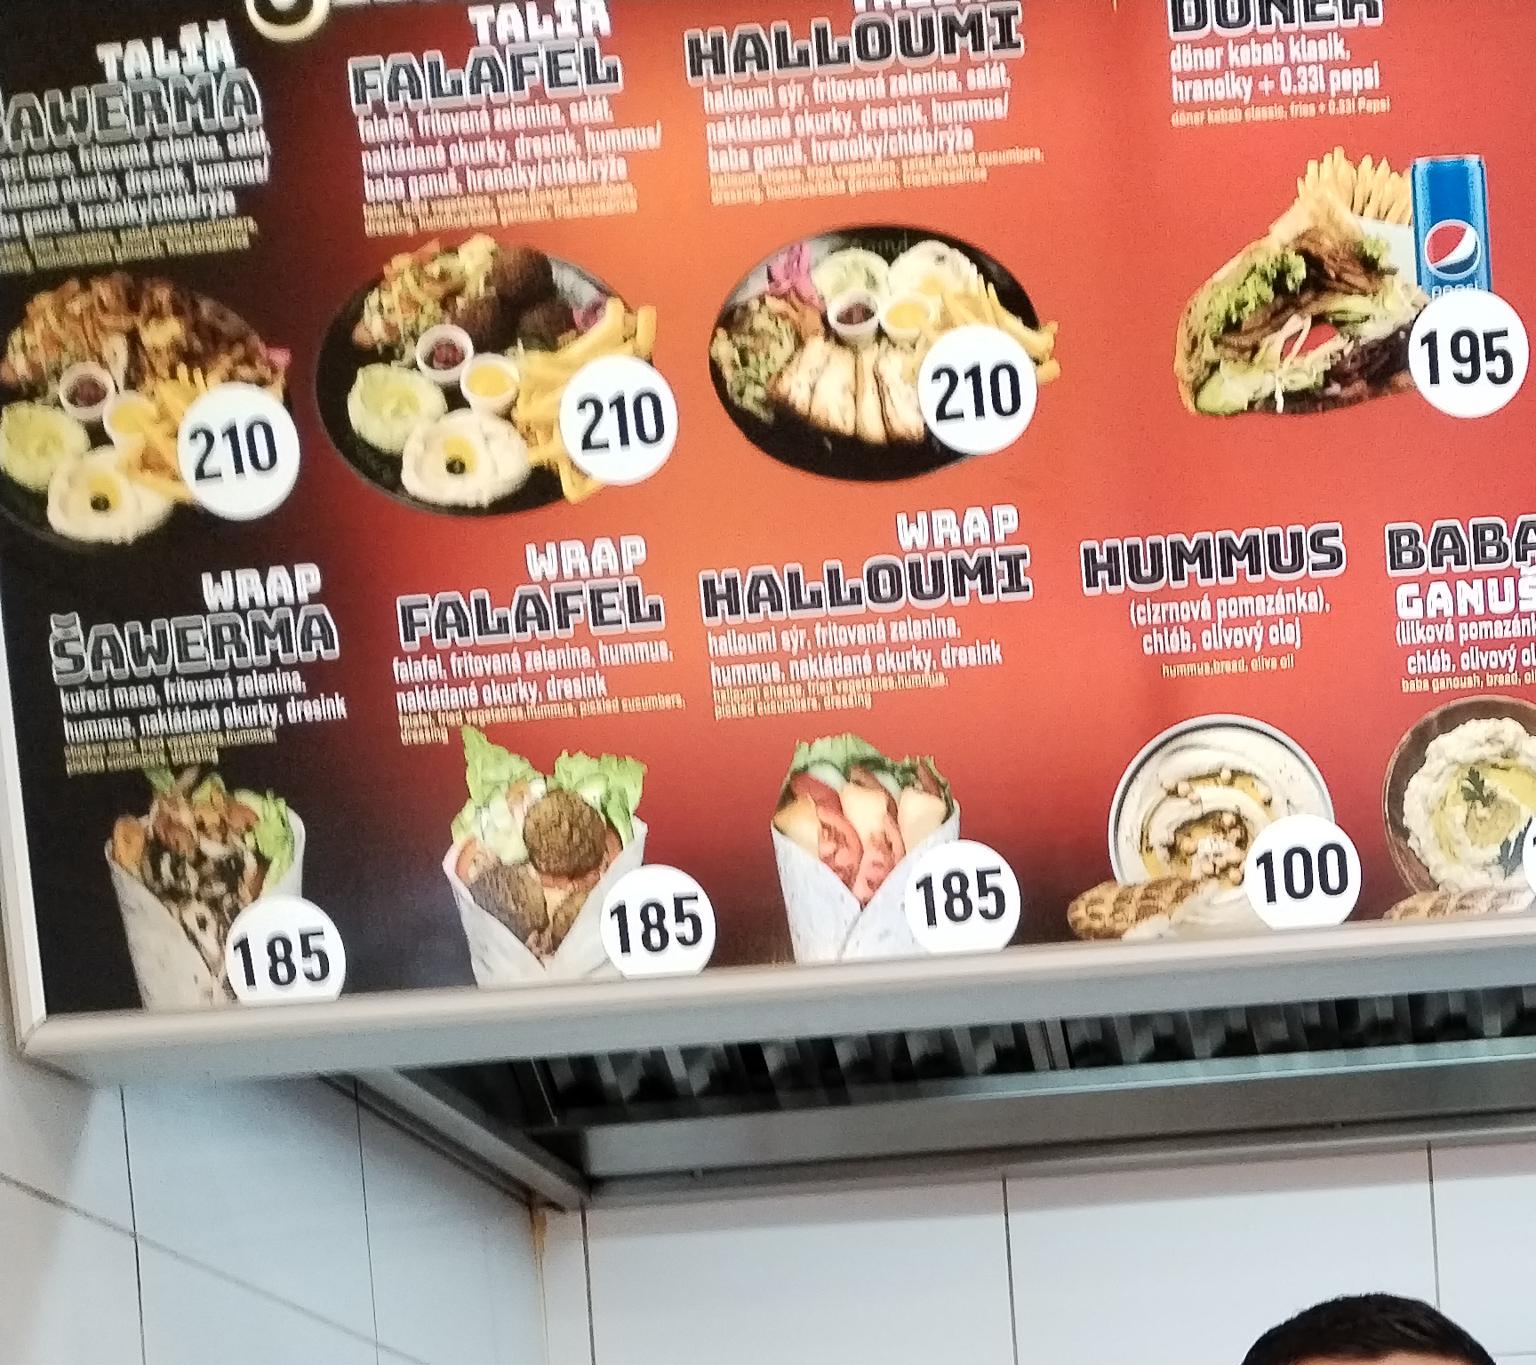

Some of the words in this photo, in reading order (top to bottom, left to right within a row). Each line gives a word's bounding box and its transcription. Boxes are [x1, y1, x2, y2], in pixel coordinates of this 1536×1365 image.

[684, 1, 1024, 86] HALLOUMI
[348, 37, 623, 116] FALAFEL
[1172, 71, 1252, 105] hranolky
[0, 67, 261, 152] AWERMA
[1418, 326, 1516, 387] 195
[577, 390, 666, 454] 210
[930, 362, 1022, 424] 210
[187, 418, 280, 483] 210
[525, 534, 647, 581] WRAP
[896, 504, 1019, 551] WRAP
[1080, 521, 1346, 596] HUMMUS
[202, 563, 321, 612] WRAP
[397, 575, 666, 651] FALAFEL
[699, 544, 1034, 626] HALLOUMI
[49, 604, 339, 686] ŠAWERMA
[915, 867, 1007, 931] 185
[1255, 843, 1348, 906] 100
[608, 892, 704, 956] 185
[232, 931, 331, 987] 185
